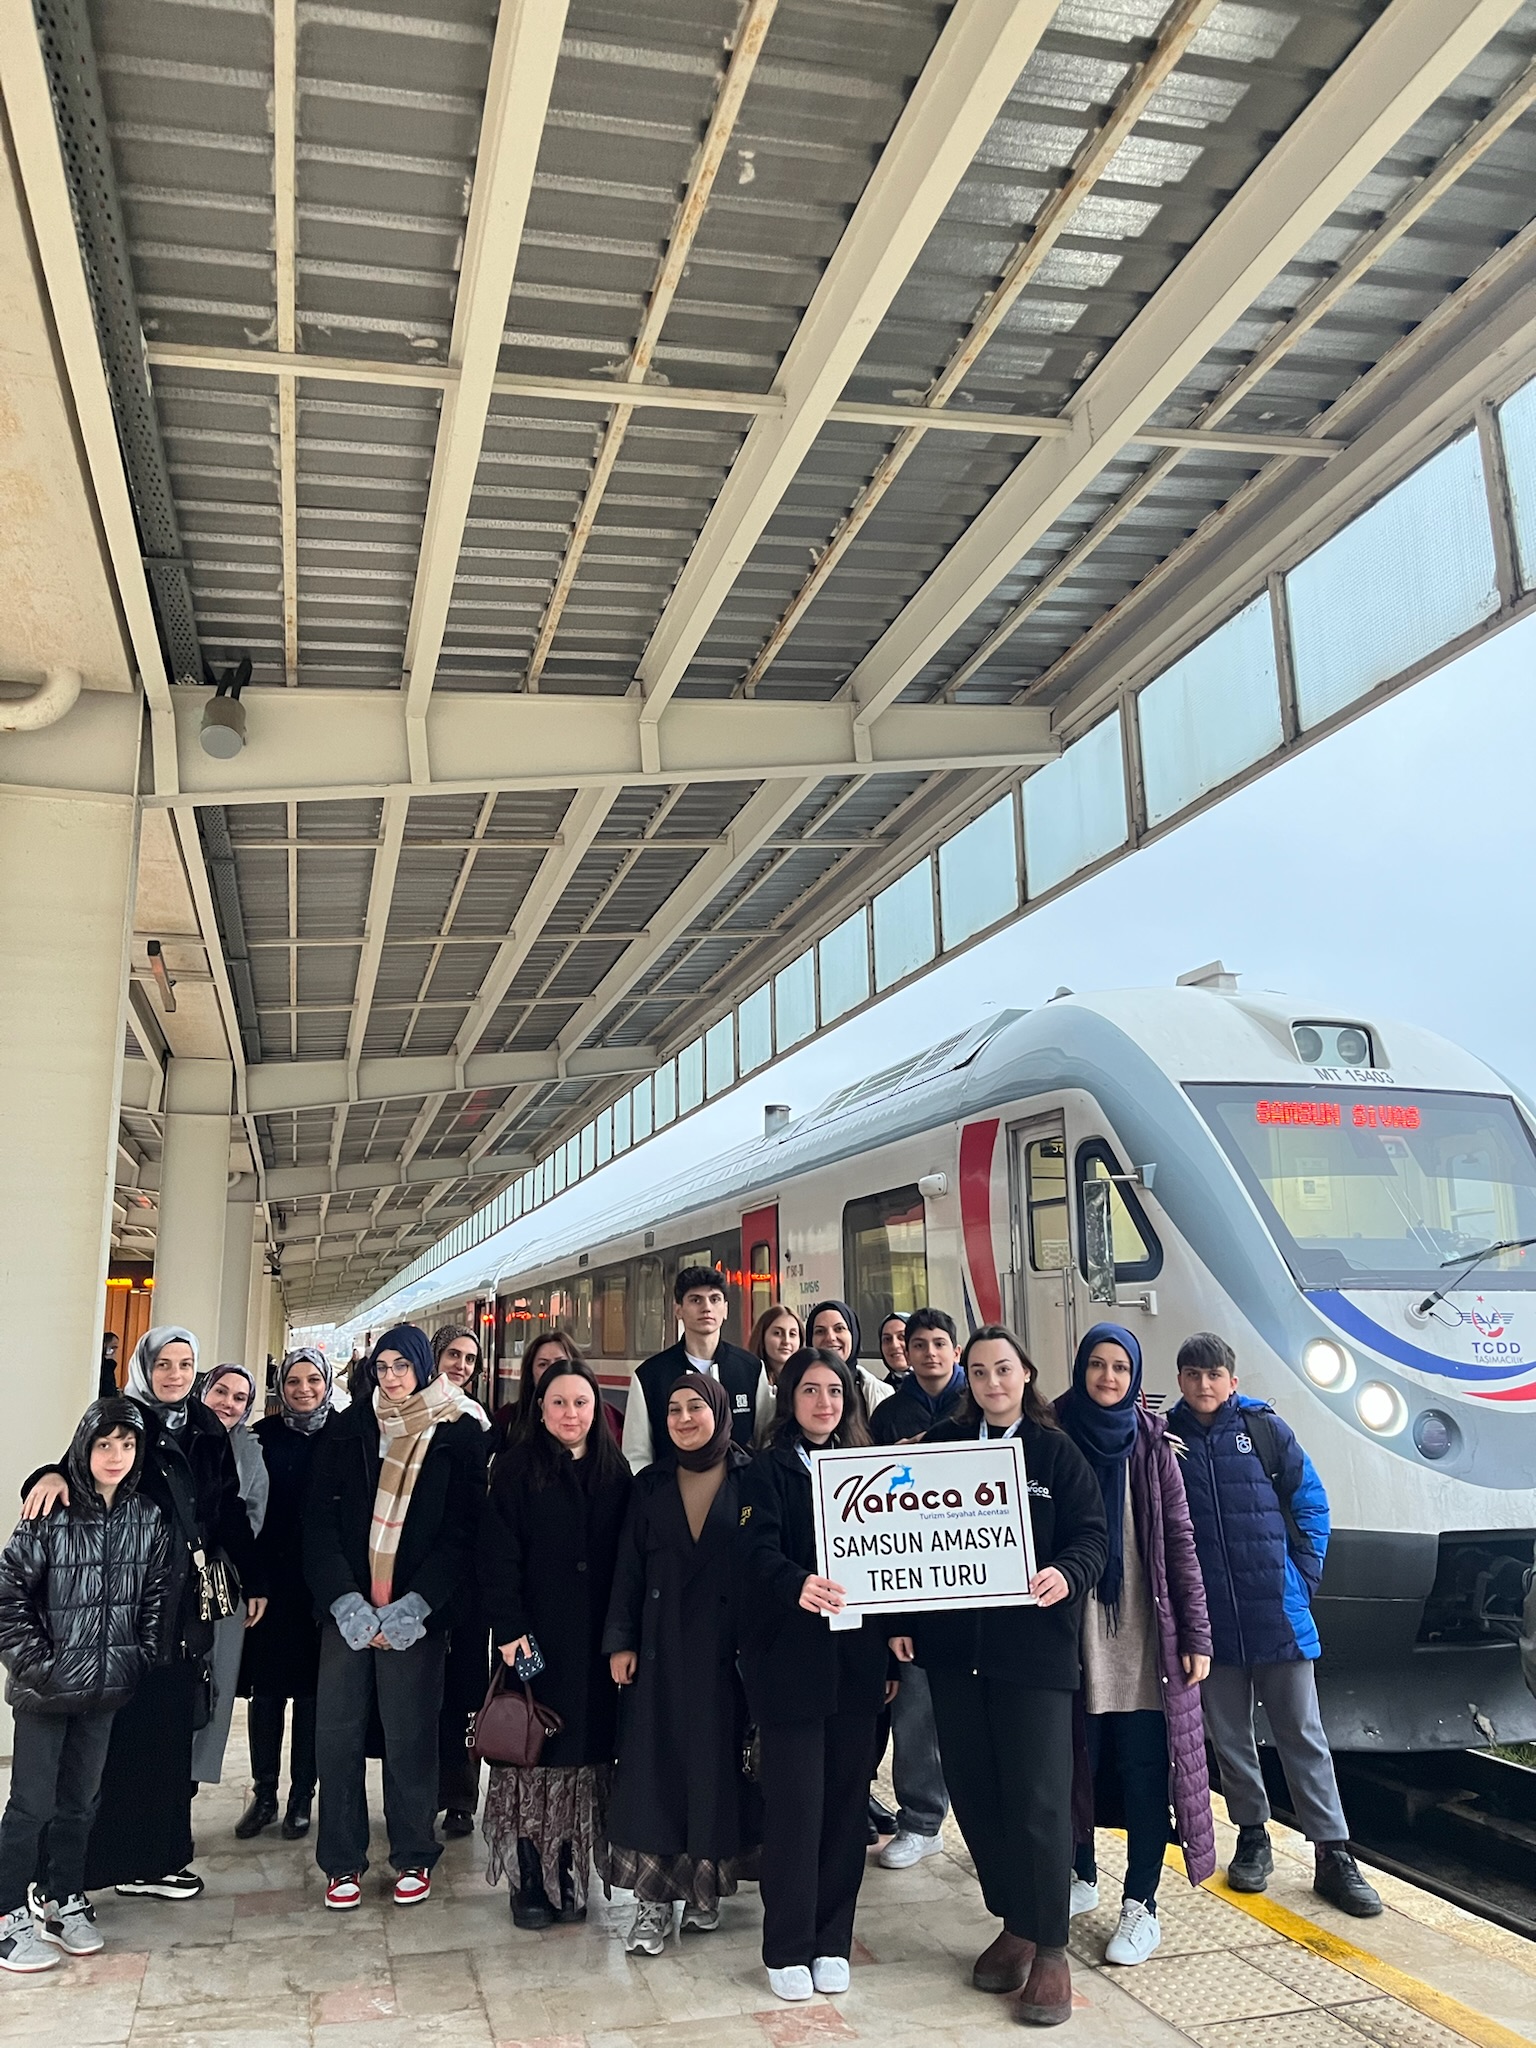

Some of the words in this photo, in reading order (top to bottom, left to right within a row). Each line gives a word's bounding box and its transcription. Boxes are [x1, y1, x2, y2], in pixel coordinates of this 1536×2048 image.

[1314, 1068, 1342, 1081] MT
[1345, 1069, 1395, 1084] 15403
[1256, 1100, 1341, 1126] SAMSUN
[1471, 1342, 1521, 1354] TCDD
[833, 1464, 963, 1524] Karaca
[974, 1481, 1008, 1506] 61
[919, 1512, 945, 1520] Turizm
[946, 1510, 976, 1519] Seyahat
[833, 1531, 923, 1558] SAMSUN
[931, 1526, 1017, 1552] AMASYA
[867, 1567, 923, 1591] TREN
[929, 1563, 987, 1587] TURU
